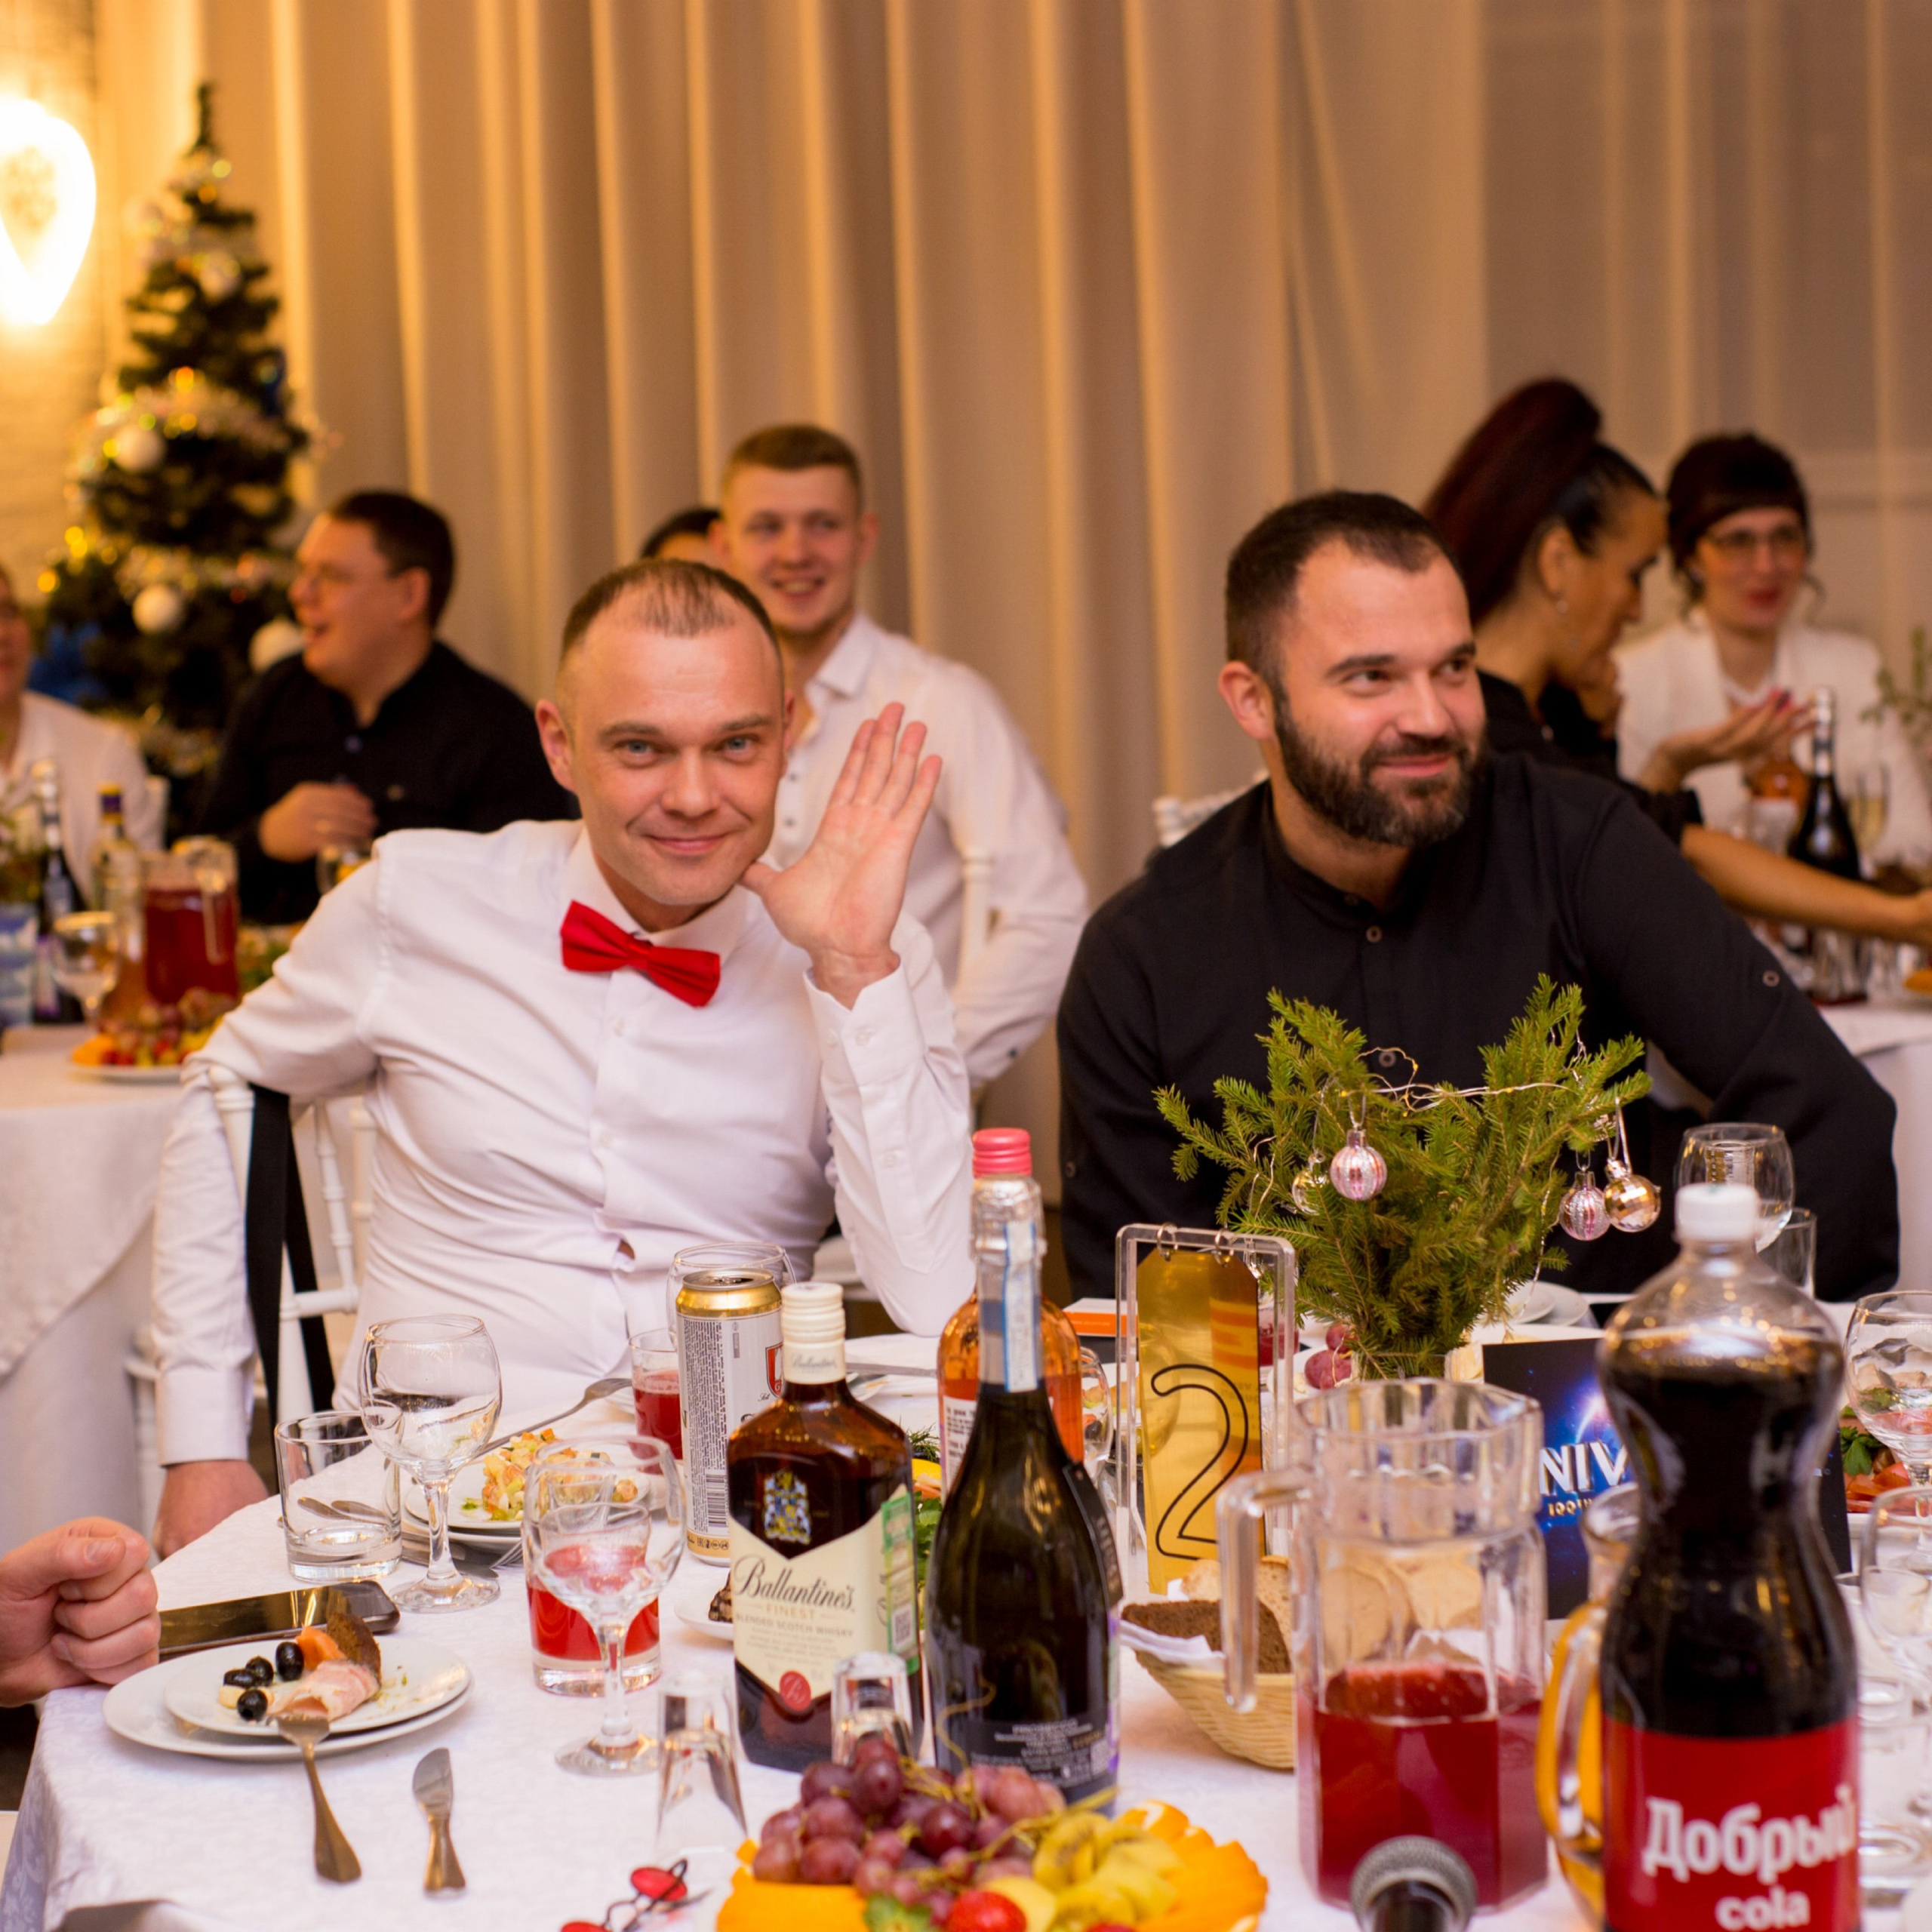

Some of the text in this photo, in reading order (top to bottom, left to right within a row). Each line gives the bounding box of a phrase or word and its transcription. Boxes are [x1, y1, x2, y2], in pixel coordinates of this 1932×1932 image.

[1150, 1364, 1249, 1561] 2
[1538, 1440, 1629, 1496] NIV
[734, 1554, 854, 1611] Ballantine's
[766, 1604, 816, 1620] FINEST
[1715, 1884, 1810, 1931] cola
